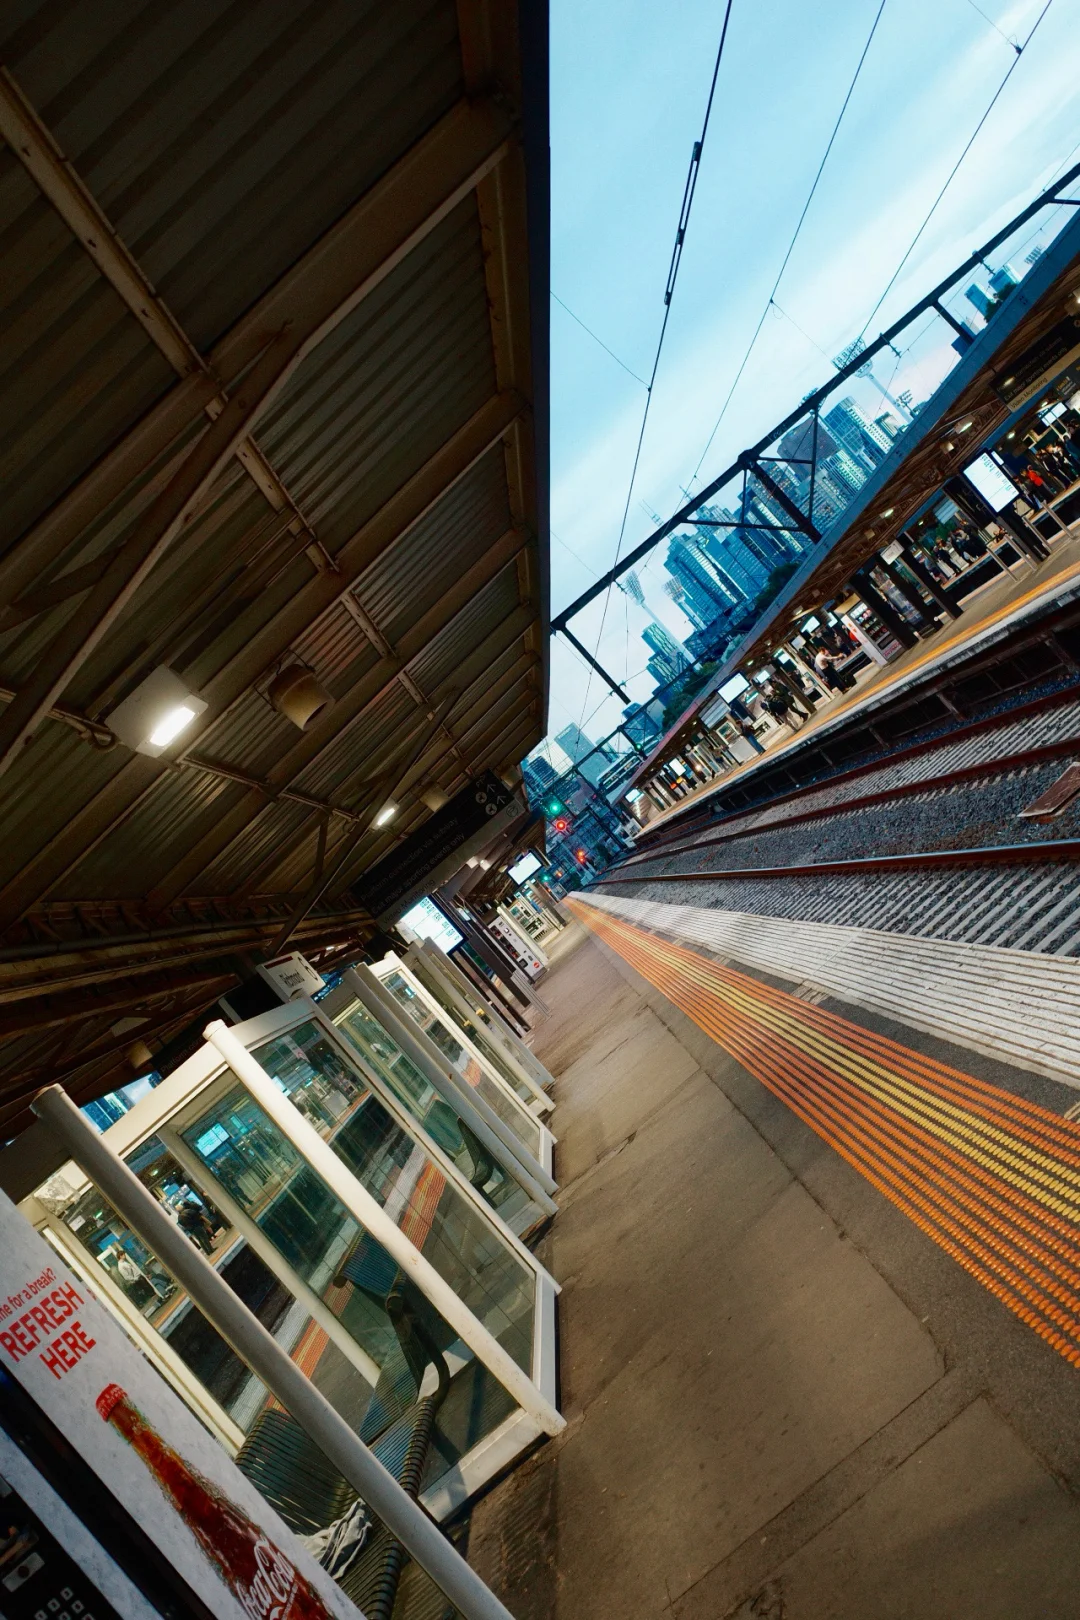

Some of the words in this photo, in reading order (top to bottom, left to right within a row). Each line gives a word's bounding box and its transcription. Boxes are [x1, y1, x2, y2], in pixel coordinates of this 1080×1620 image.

[1025, 367, 1044, 386] sporting
[1023, 377, 1048, 398] Monitoring
[451, 832, 465, 847] only
[26, 1267, 57, 1295] break?
[7, 1293, 25, 1310] for
[22, 1289, 32, 1300] a
[0, 1281, 84, 1362] REFRESH
[39, 1321, 97, 1380] HERE
